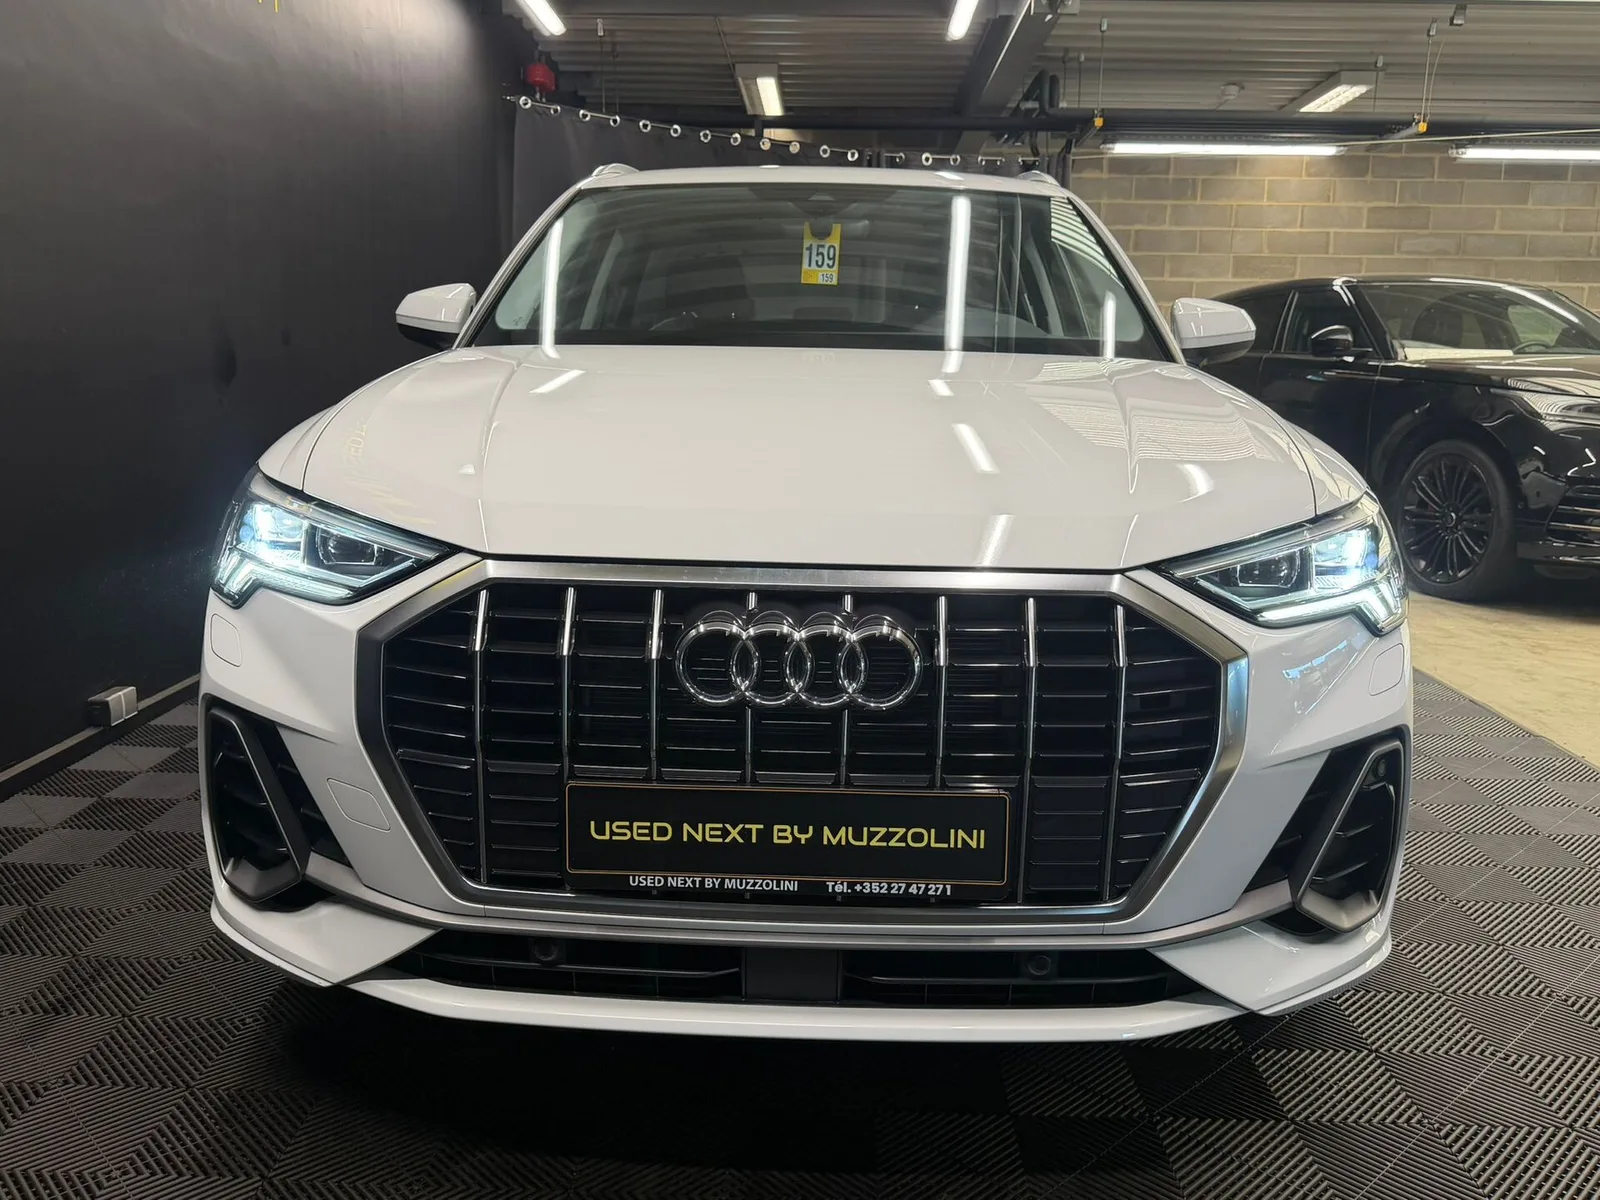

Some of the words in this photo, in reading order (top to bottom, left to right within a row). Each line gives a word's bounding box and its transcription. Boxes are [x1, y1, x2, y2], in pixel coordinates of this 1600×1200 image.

[805, 243, 837, 269] 159
[821, 273, 834, 283] 159
[590, 821, 672, 841] USED
[683, 823, 764, 843] NEXT
[773, 825, 813, 844] BY
[823, 826, 985, 849] MUZZOLINI
[629, 875, 664, 887] USED
[668, 876, 702, 888] NEXT
[705, 878, 721, 889] BY
[725, 879, 798, 891] MUZZOLINI
[826, 880, 851, 893] Tél.
[854, 882, 888, 894] +352
[890, 883, 904, 894] 27
[909, 884, 925, 895] 47
